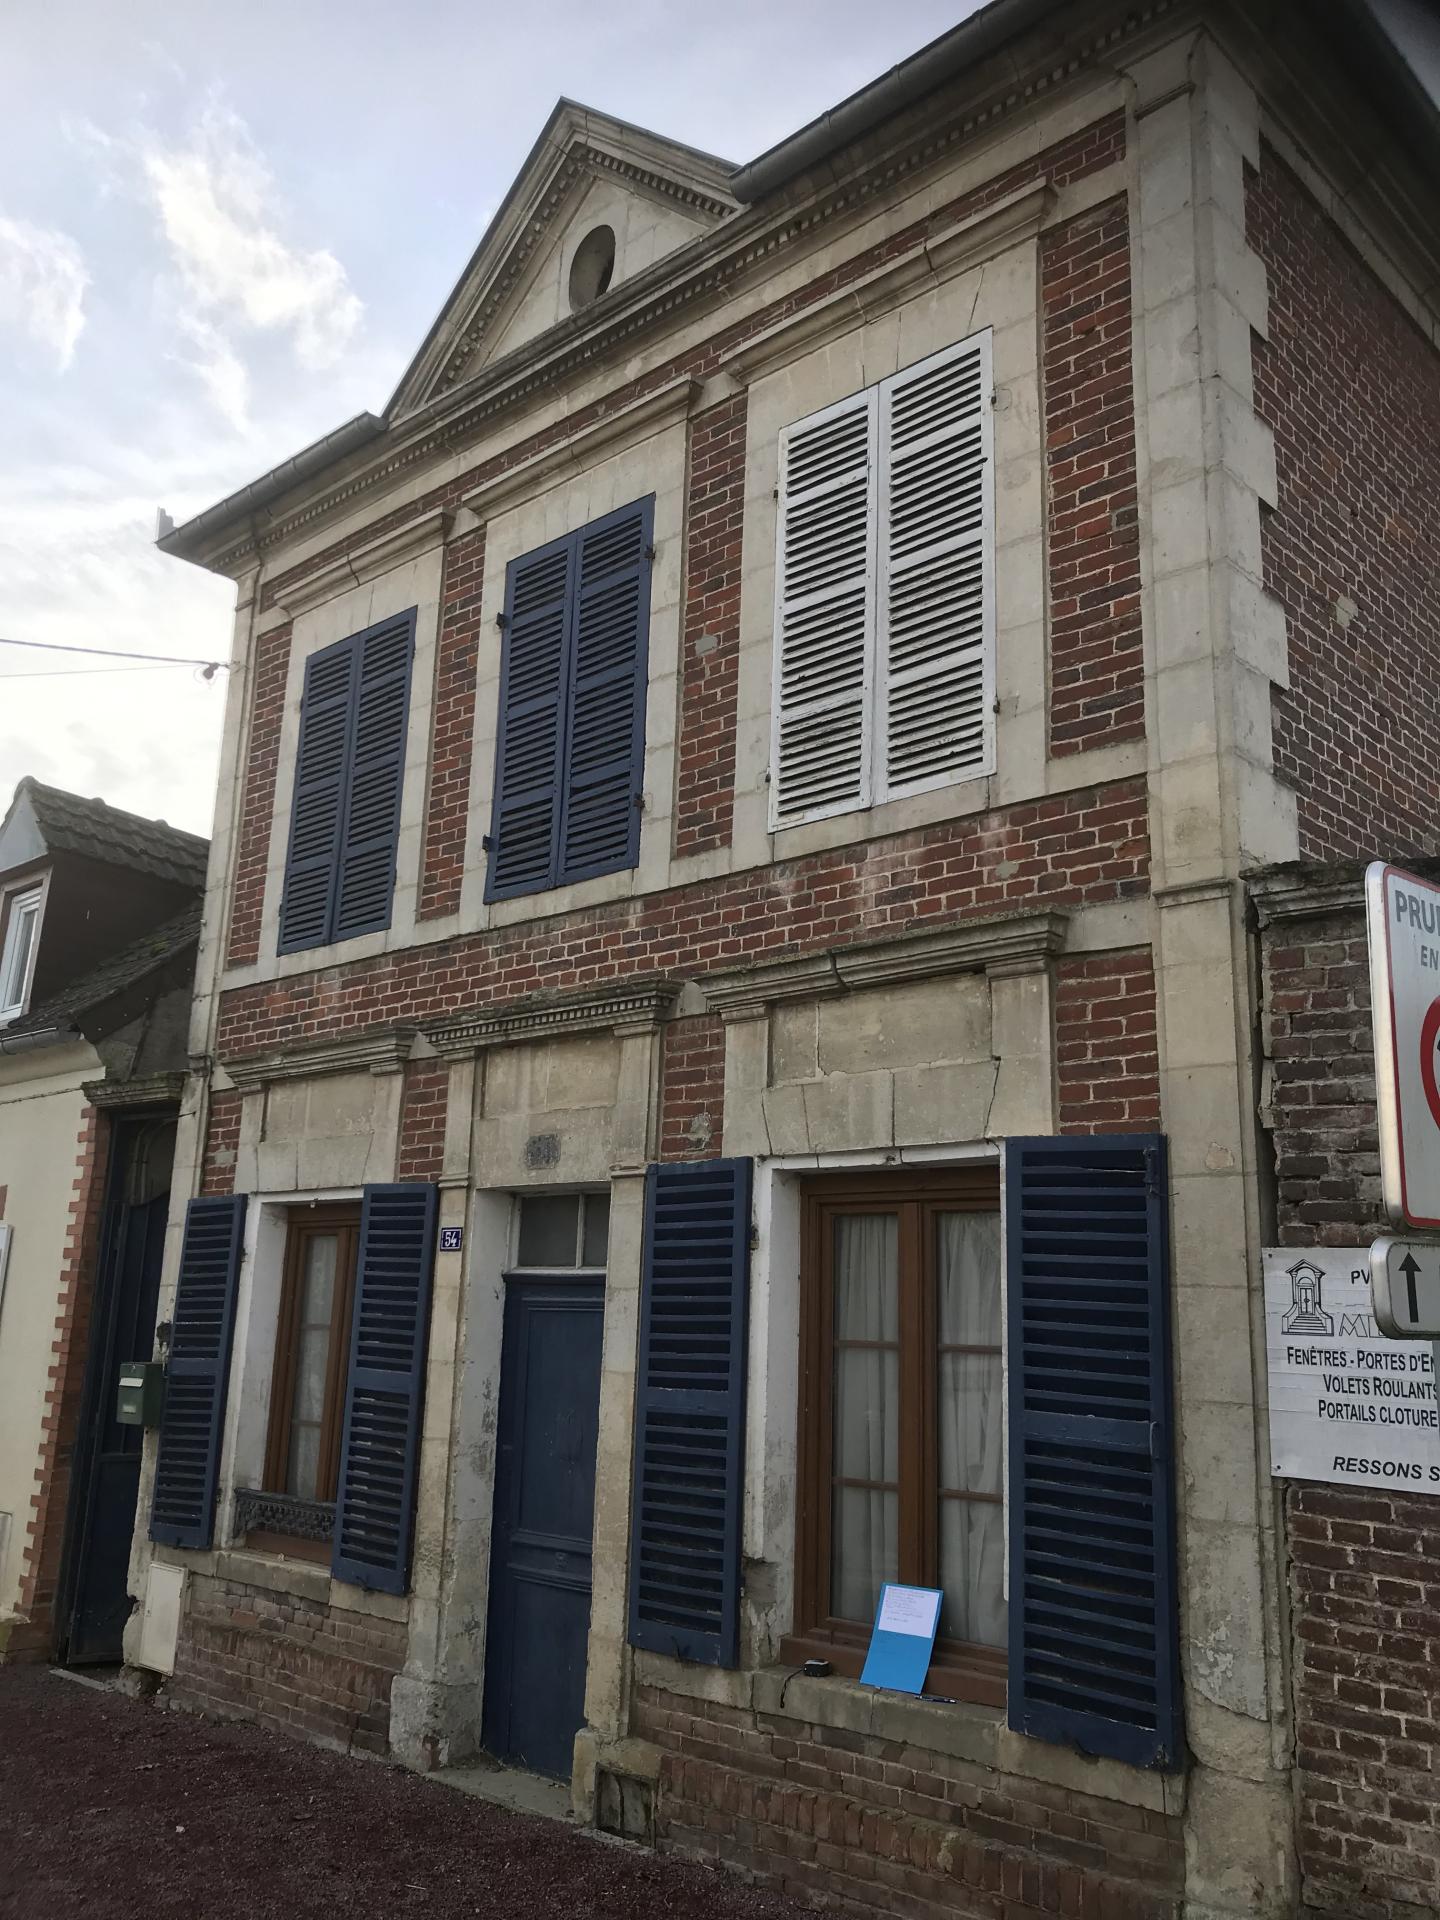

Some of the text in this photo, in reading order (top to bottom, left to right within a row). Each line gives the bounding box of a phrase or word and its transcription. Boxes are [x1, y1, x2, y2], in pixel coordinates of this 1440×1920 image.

[1394, 889, 1440, 936] PRU
[444, 1231, 457, 1247] 54
[1357, 1350, 1406, 1371] PORTES
[1323, 1373, 1370, 1395] VOLETS
[1318, 1399, 1376, 1421] PORTAILS
[1333, 1456, 1422, 1479] RESSONS
